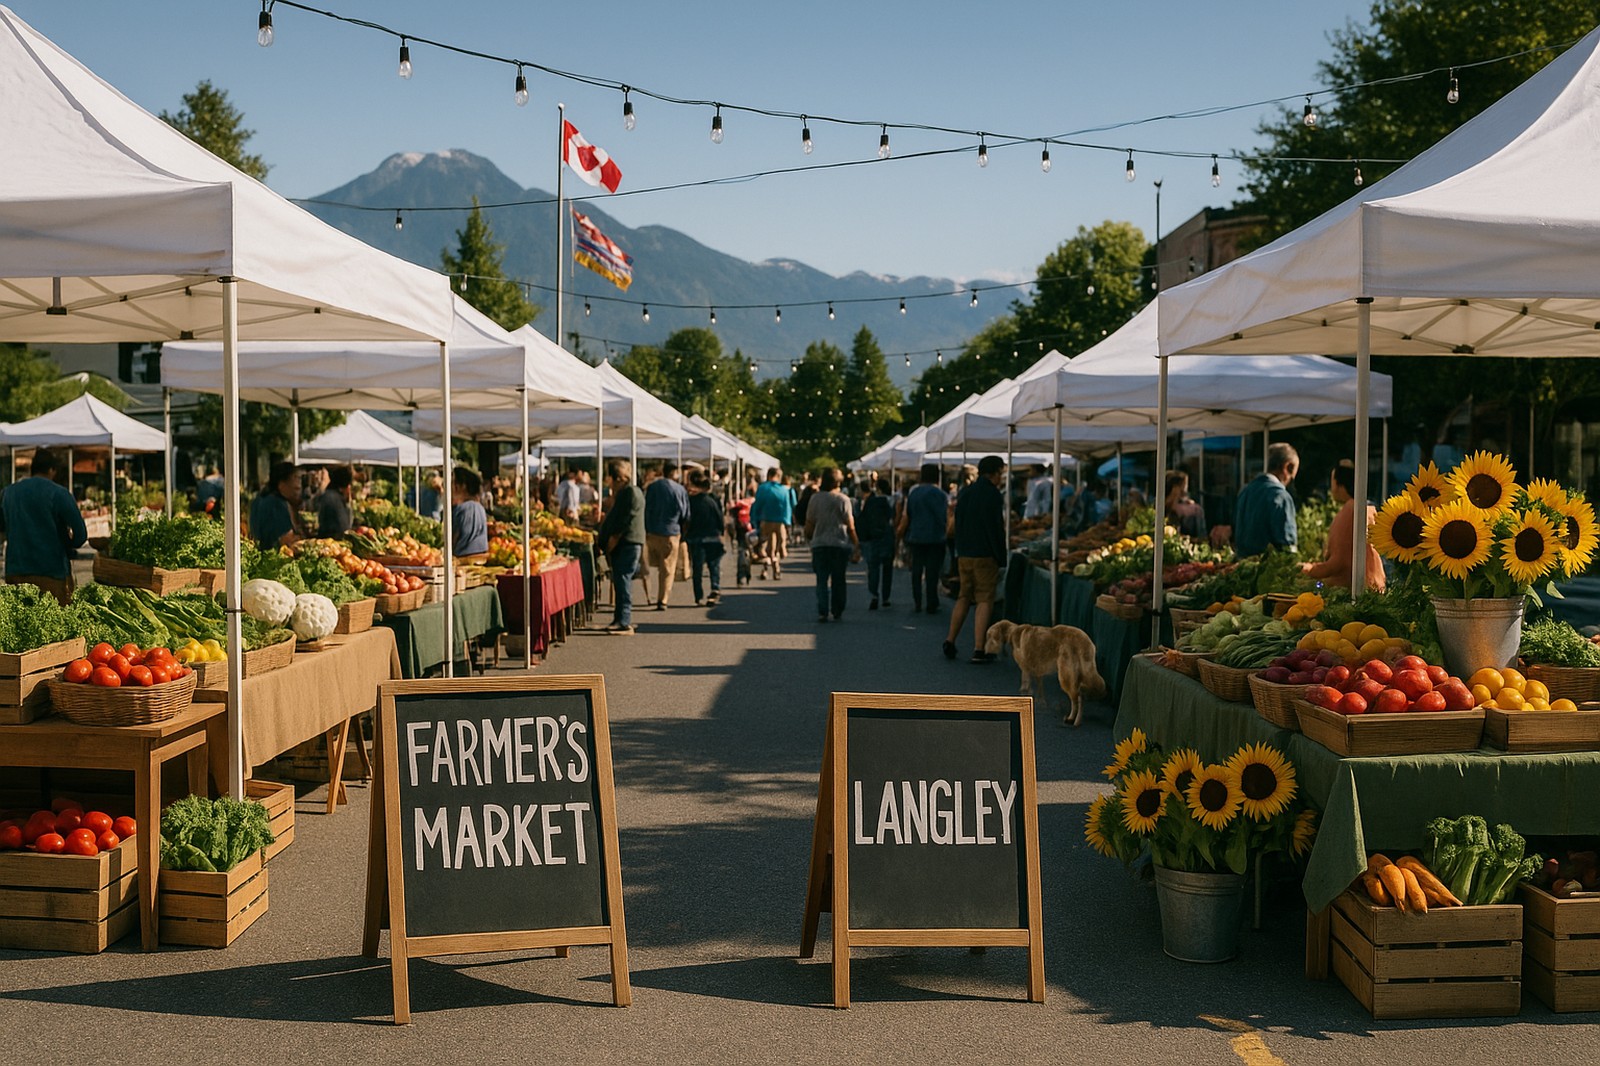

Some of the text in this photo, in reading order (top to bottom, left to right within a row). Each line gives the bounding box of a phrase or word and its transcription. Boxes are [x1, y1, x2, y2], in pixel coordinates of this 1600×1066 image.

[406, 715, 589, 787] FARMER'S
[414, 802, 591, 871] MARKET
[854, 779, 1018, 846] LANGLEY
